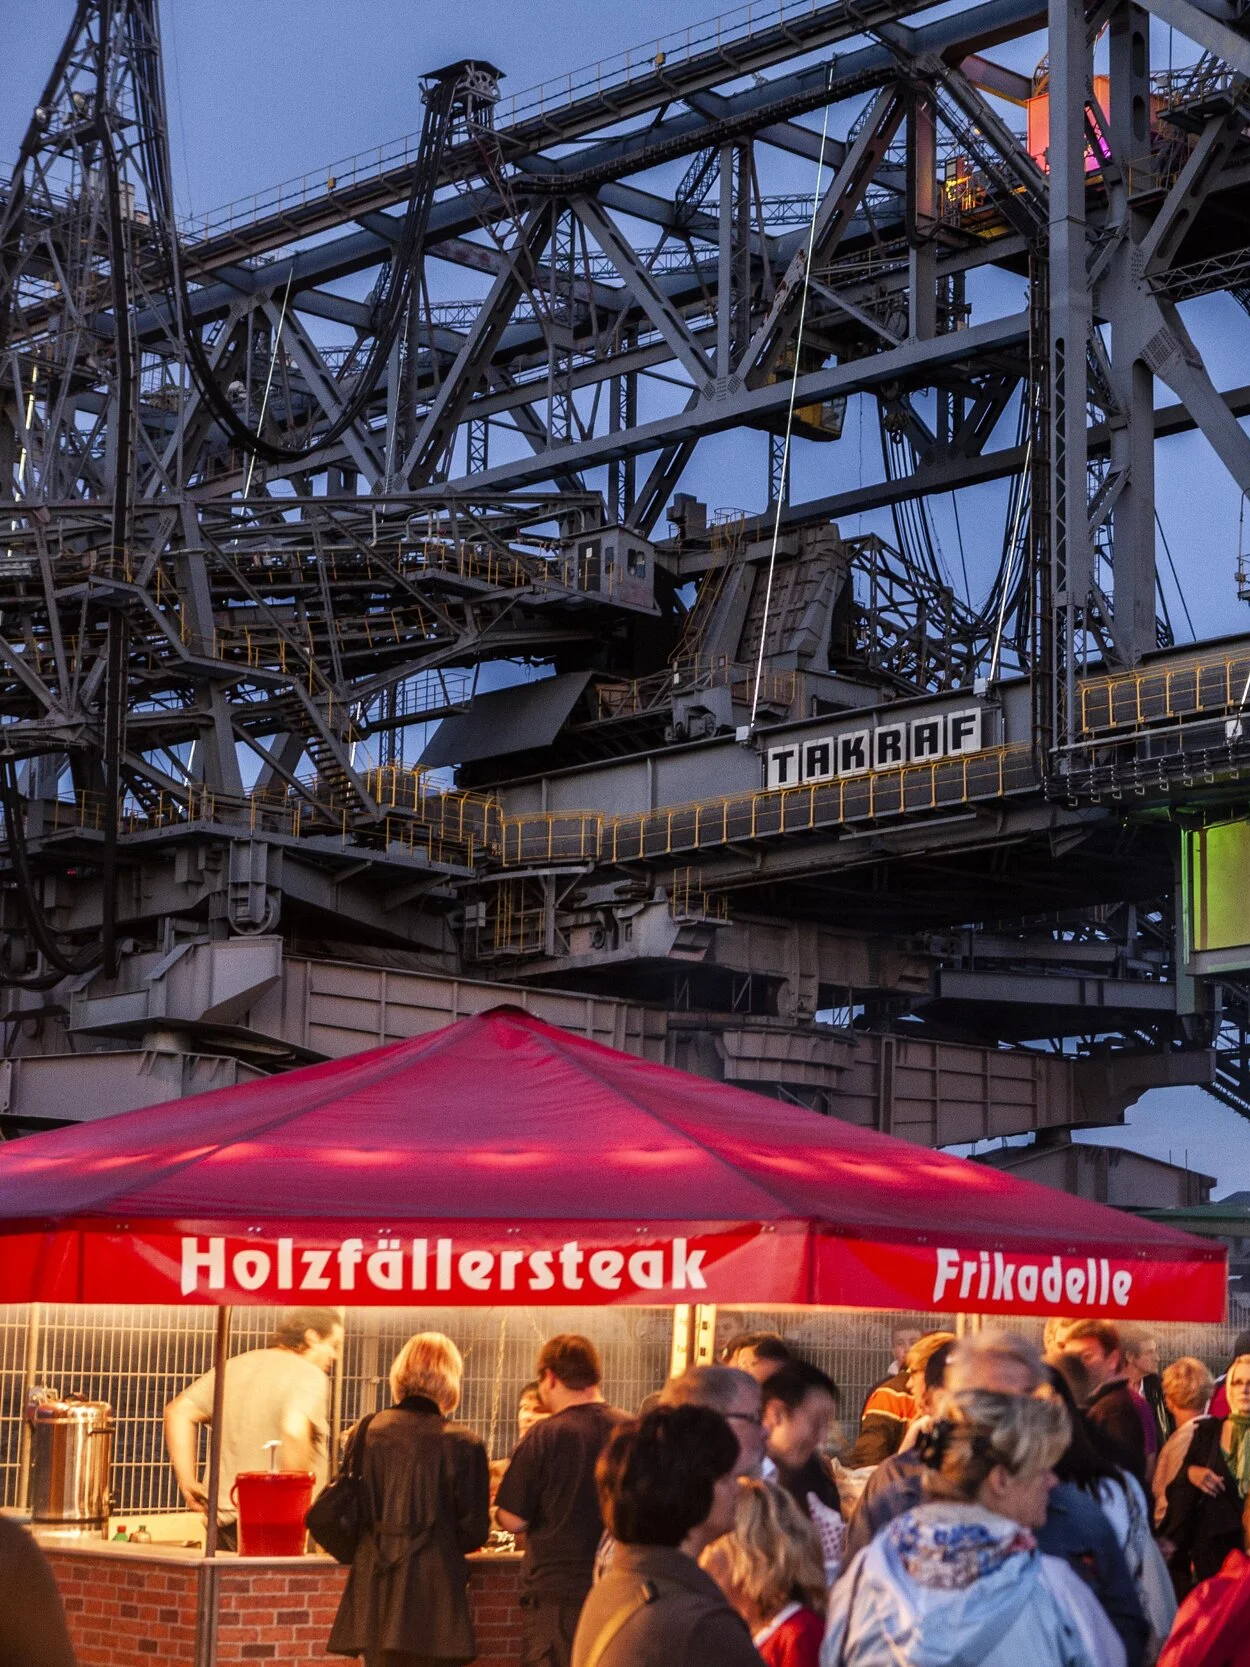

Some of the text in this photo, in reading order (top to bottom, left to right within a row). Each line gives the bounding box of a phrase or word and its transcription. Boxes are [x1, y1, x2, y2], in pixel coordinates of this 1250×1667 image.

[771, 712, 977, 784] TAKRAF
[180, 1237, 708, 1296] Holzfällersteak
[933, 1247, 1133, 1306] Frikadelle
